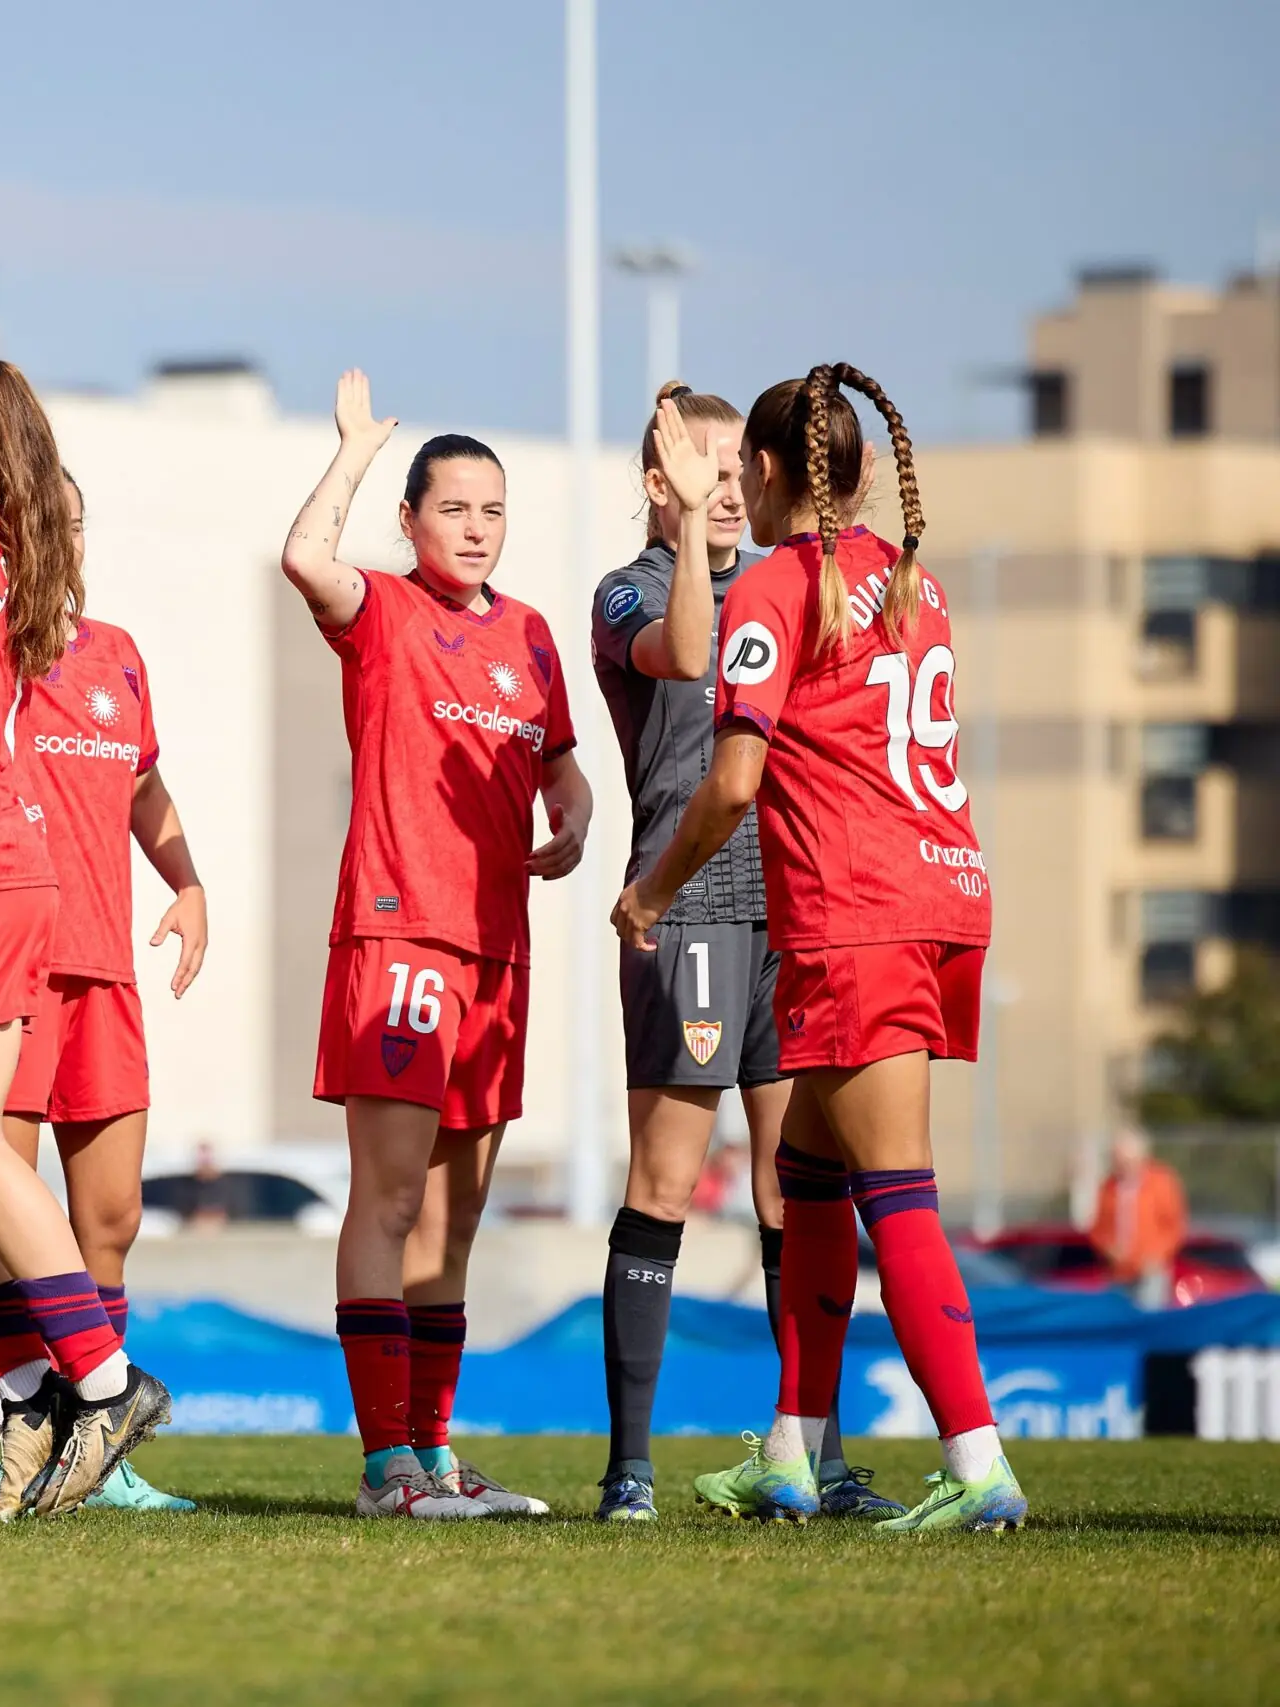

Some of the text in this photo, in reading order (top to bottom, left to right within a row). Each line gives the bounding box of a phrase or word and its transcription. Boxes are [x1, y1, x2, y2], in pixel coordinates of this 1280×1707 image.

[727, 636, 771, 673] JD
[432, 700, 546, 753] socialenerg
[865, 644, 969, 813] 19
[387, 962, 445, 1034] 16
[687, 942, 710, 1008] 1
[626, 1268, 666, 1285] SFC
